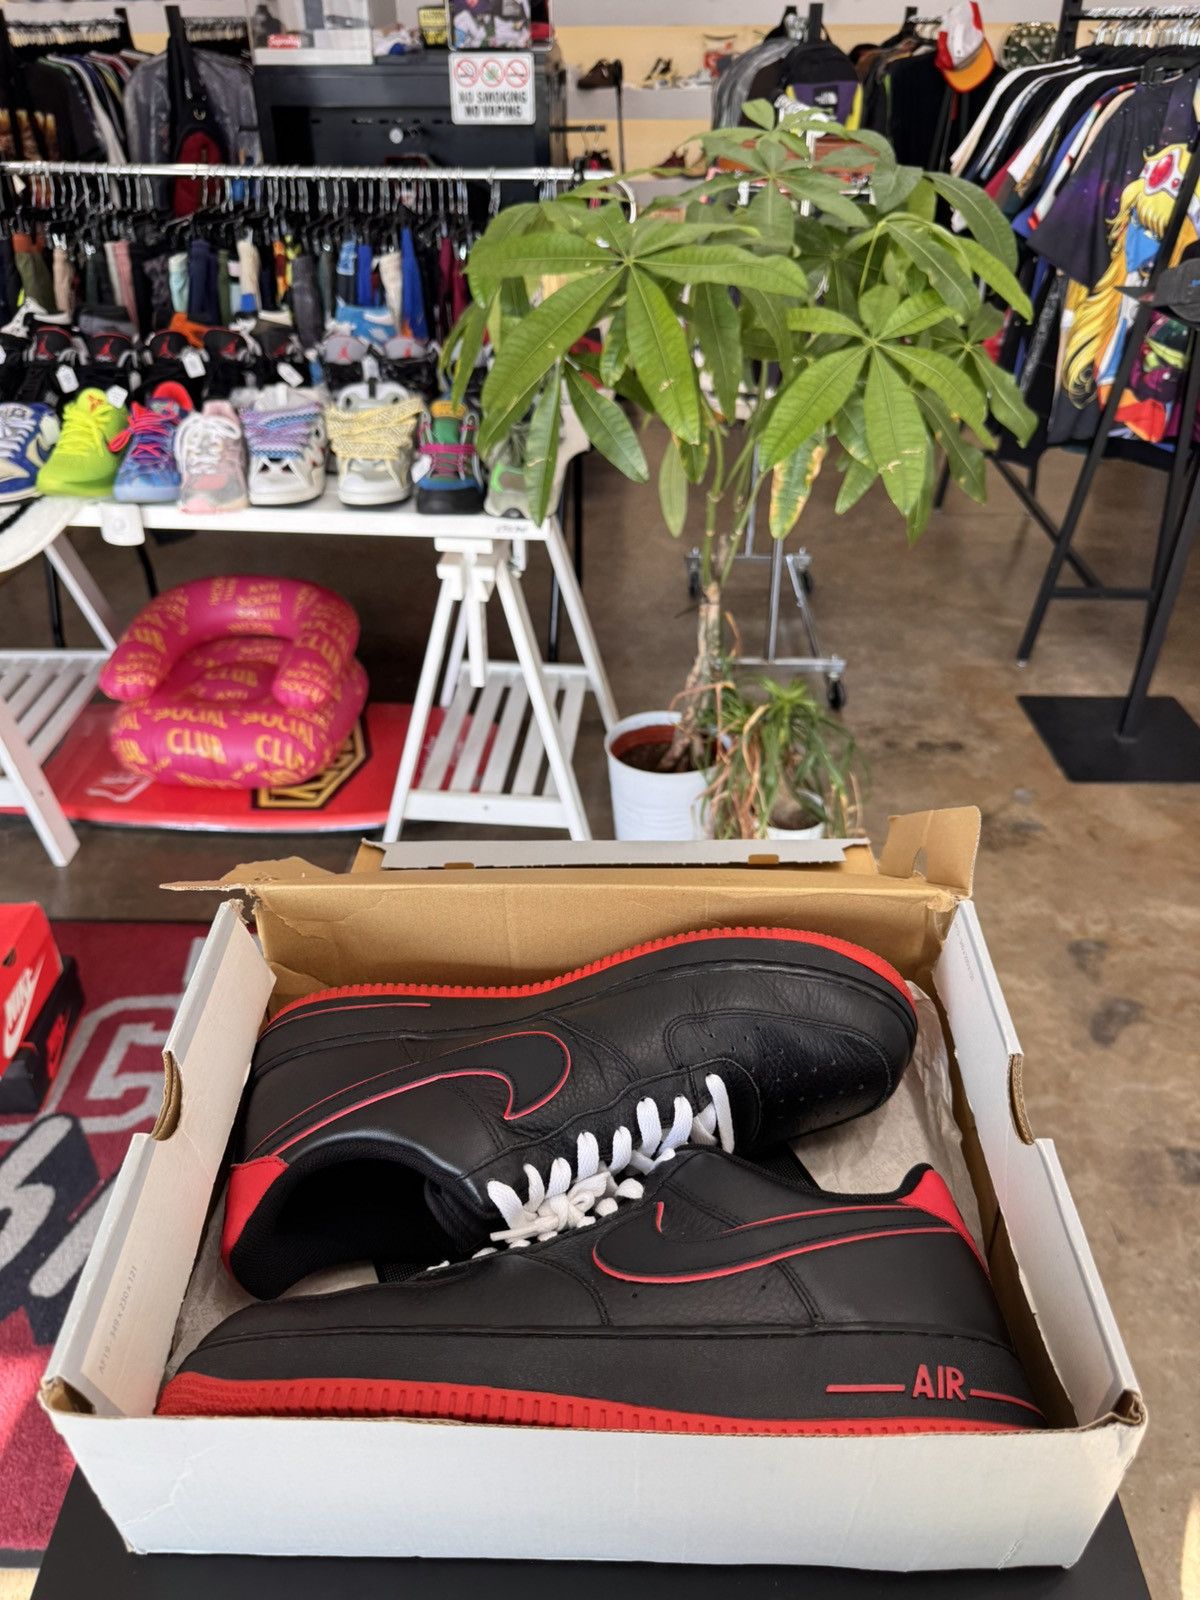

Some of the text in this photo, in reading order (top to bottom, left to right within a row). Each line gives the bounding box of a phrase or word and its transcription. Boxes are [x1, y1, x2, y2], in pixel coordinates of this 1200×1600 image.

[458, 91, 527, 104] NO SMOKING
[465, 105, 522, 118] NO VAPING
[912, 1363, 967, 1400] AIR
